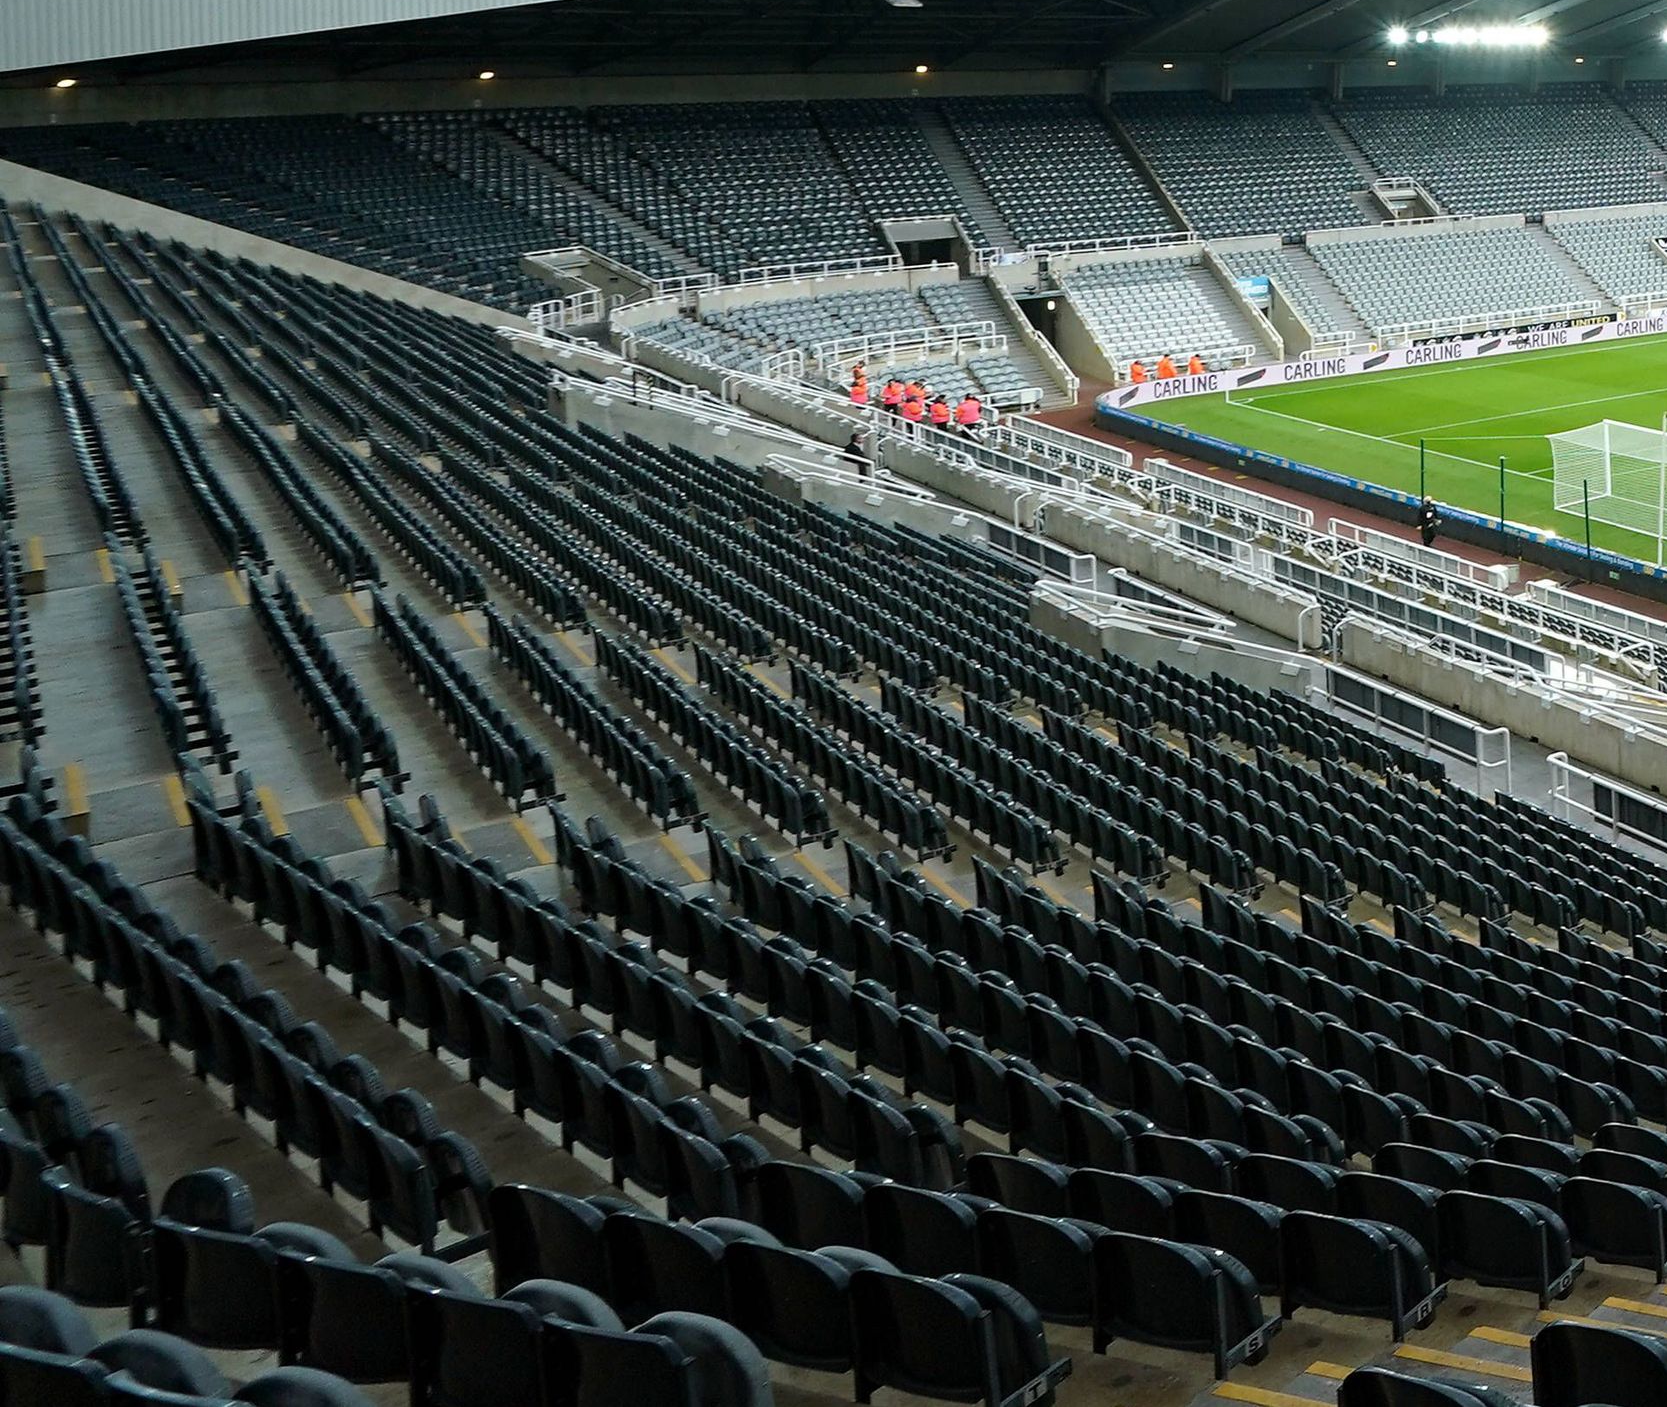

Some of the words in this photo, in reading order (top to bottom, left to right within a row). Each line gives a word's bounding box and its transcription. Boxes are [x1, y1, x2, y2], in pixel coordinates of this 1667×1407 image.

[1571, 316, 1610, 327] UNITED
[1616, 317, 1663, 337] CARLING
[1516, 330, 1567, 349] CARLING
[1405, 343, 1461, 365] CARLING
[1284, 358, 1345, 382] CARLING
[1154, 374, 1218, 399] CARLING
[1420, 1303, 1430, 1318] R
[1249, 1336, 1259, 1353] S
[1028, 1382, 1041, 1398] T
